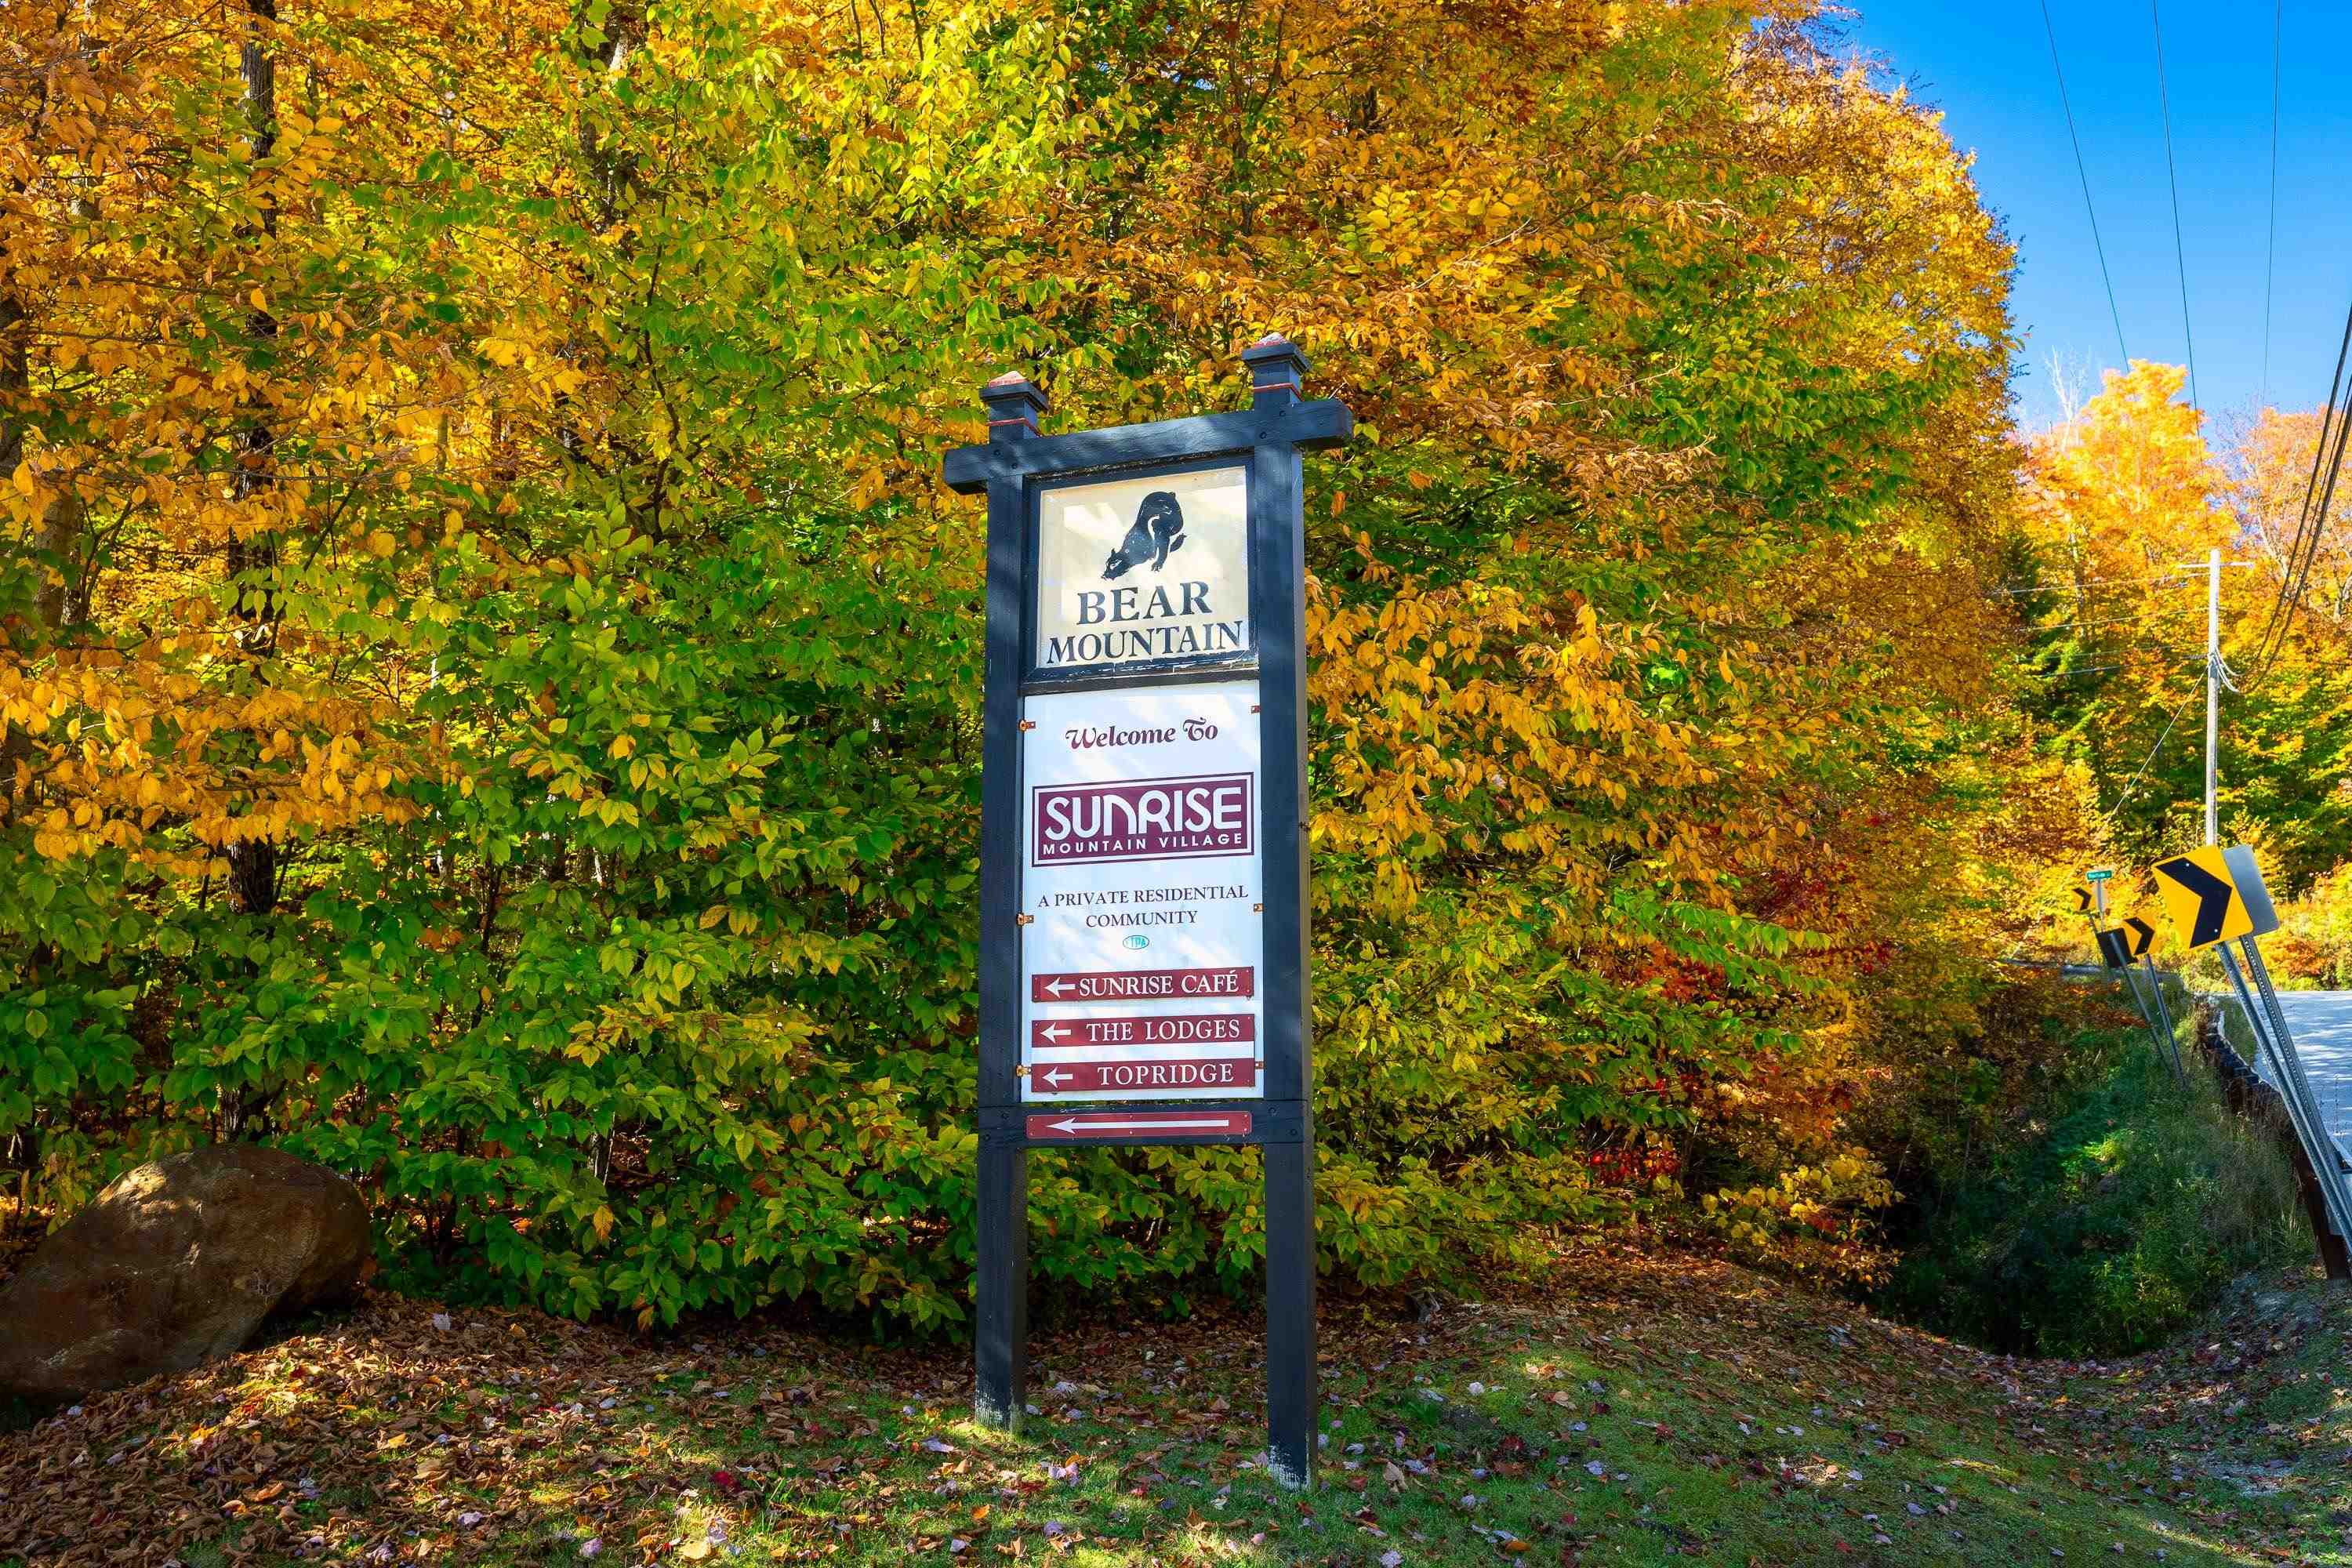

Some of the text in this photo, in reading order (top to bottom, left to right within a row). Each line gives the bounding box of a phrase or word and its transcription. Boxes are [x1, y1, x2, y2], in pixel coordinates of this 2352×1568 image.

[1076, 581, 1212, 625] BEAR
[1047, 620, 1243, 664] MOUNTAIN
[1065, 717, 1218, 750] Welcome To
[1045, 787, 1242, 840] SUNRISE
[1043, 833, 1242, 855] MOUNTAIN VILLAGE
[1038, 885, 1248, 908] A PRIVATE RESIDENTIAL
[1086, 910, 1198, 928] COMMUNITY
[1078, 970, 1239, 997] SUNRISE CAFÉ
[1086, 1019, 1240, 1042] THE LODGES
[1098, 1064, 1234, 1087] TOPRIDGE
